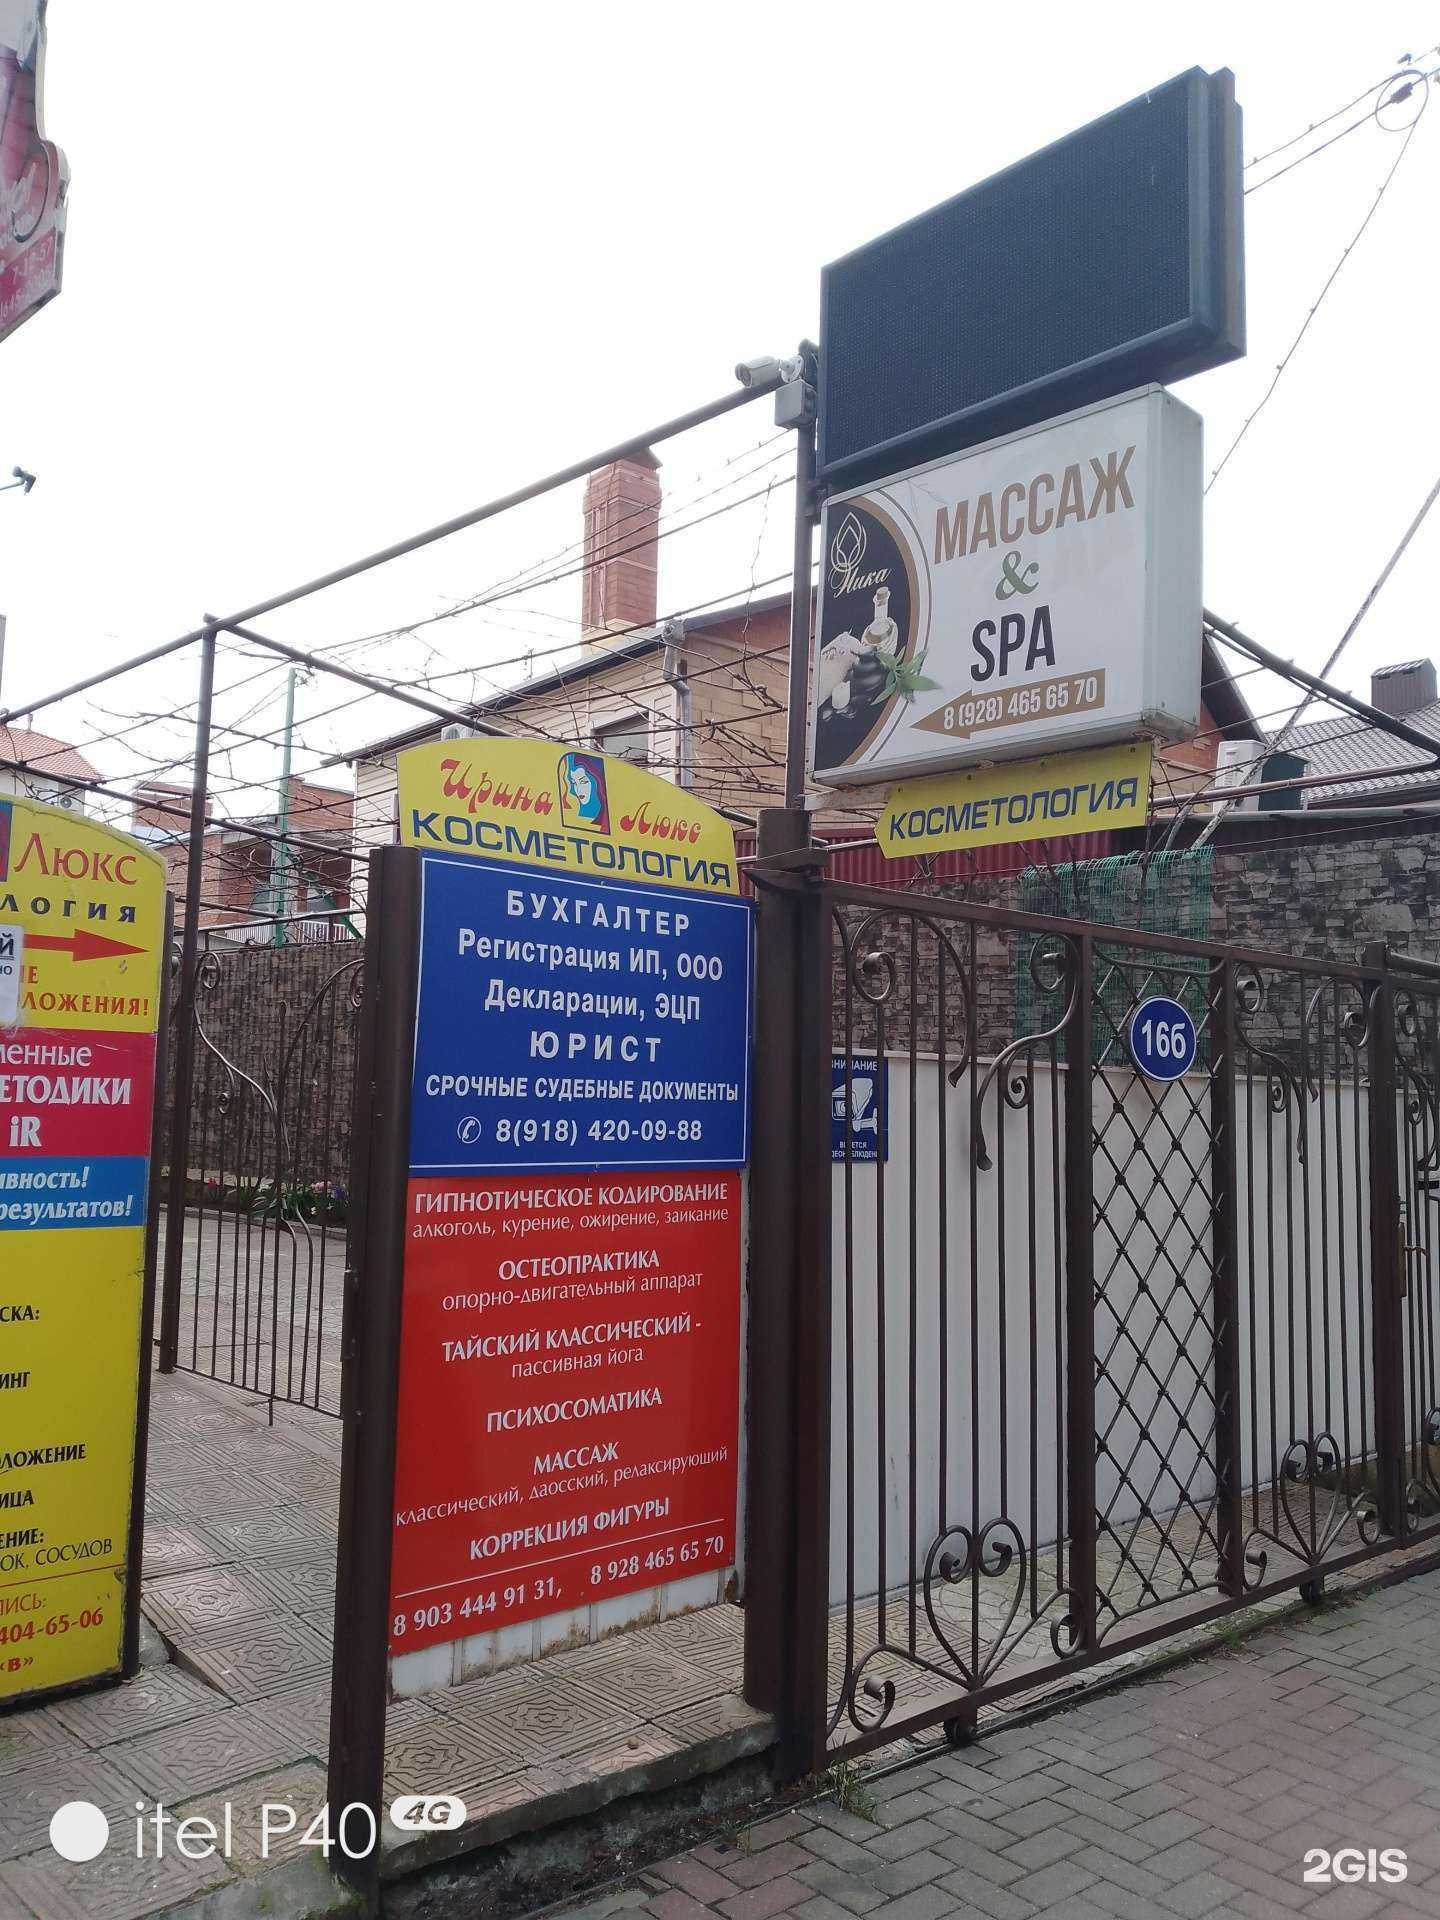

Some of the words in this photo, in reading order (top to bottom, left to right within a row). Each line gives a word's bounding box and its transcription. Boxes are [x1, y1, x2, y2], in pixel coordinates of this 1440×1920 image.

[934, 446, 1137, 565] МАССАЖ
[995, 550, 1040, 601] &
[970, 605, 1056, 682] SPA
[944, 707, 954, 730] 8
[958, 696, 1003, 727] (928)
[1007, 687, 1041, 717] 465
[1045, 682, 1068, 710] 65
[1074, 676, 1097, 705] 70
[440, 758, 554, 814] Ирина
[620, 802, 701, 843] Люкс
[889, 776, 1138, 841] КОСМЕТОЛОГИЯ
[411, 809, 731, 887] КОСМЕТОЛОГИЯ
[507, 890, 690, 937] БУХГАЛТЕР
[458, 929, 620, 972] Регистрация
[629, 947, 668, 980] ИП,
[677, 953, 723, 981] ООО
[484, 979, 645, 1021] Декларации,
[654, 994, 700, 1024] ЭЦП
[530, 1031, 661, 1063] ЮРИСТ
[426, 1075, 528, 1098] СРОЧНЫЕ
[534, 1077, 633, 1101] СУДЕБНЫЕ
[639, 1081, 738, 1103] ДОКУМЕНТЫ
[9, 1116, 42, 1148] iR
[495, 1119, 578, 1147] 8(918)
[588, 1119, 702, 1142] 420-09-88
[415, 1187, 593, 1214] ГИПНОТИЧЕСКОЕ
[598, 1183, 728, 1206] КОДИРОВАНИЕ
[412, 1221, 496, 1238] алкоголь,
[502, 1216, 574, 1239] курение,
[580, 1211, 660, 1232] ожирение,
[664, 1207, 729, 1225] заикание
[498, 1250, 660, 1281] ОСТЕОПРАКТИКА
[442, 1275, 635, 1313] опорно-двигательный
[640, 1273, 704, 1294] аппарат
[442, 1328, 540, 1363] ТАЙСКИЙ
[546, 1311, 692, 1349] КЛАССИЧЕСКИЙ
[511, 1351, 602, 1379] пассивная
[607, 1345, 644, 1368] йога
[486, 1387, 663, 1433] ПСИХОСОМАТИКА
[533, 1441, 619, 1476] МАССАЖ
[395, 1487, 525, 1527] классический,
[529, 1470, 608, 1500] даосский,
[613, 1446, 728, 1488] релаксирующий
[36, 1538, 112, 1566] СОСУДОВ
[470, 1514, 588, 1560] КОРРЕКЦИЯ
[594, 1498, 670, 1531] ФИГУРЫ
[393, 1614, 406, 1637] 8
[414, 1602, 452, 1629] 903
[459, 1592, 497, 1620] 444
[504, 1584, 526, 1608] 91
[534, 1577, 561, 1599] 31,
[590, 1565, 602, 1585] 8
[607, 1555, 639, 1581] 928
[645, 1546, 675, 1571] 465
[680, 1541, 700, 1563] 65
[705, 1535, 725, 1557] 70
